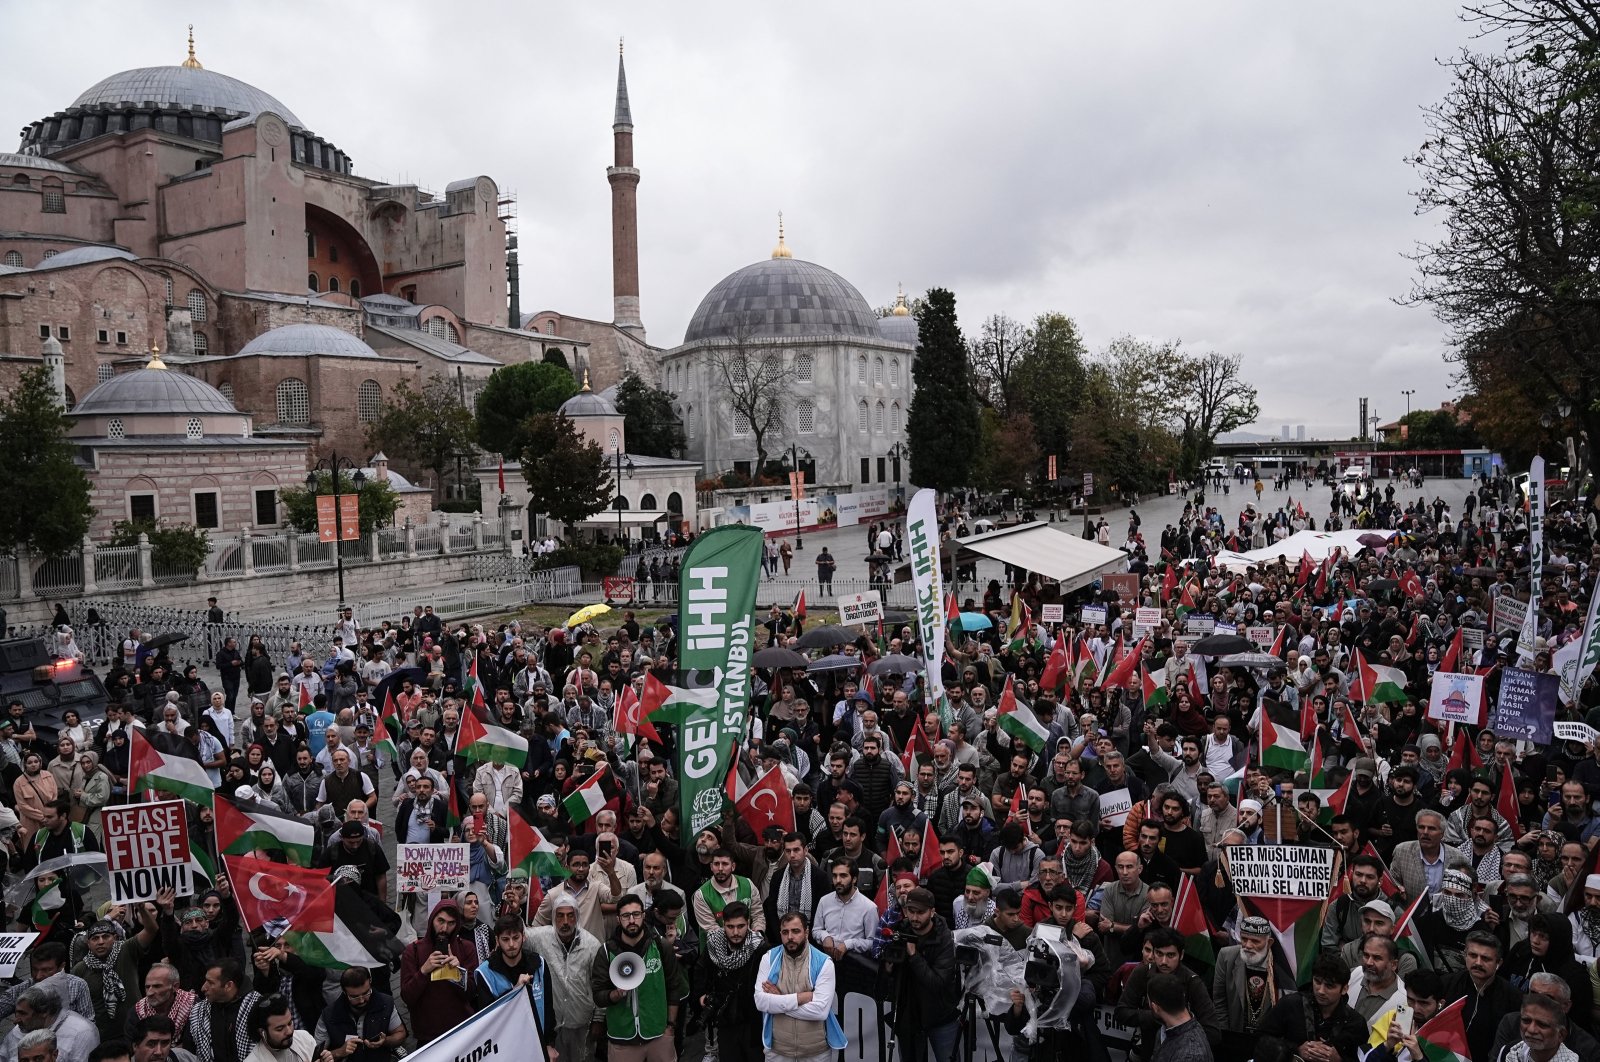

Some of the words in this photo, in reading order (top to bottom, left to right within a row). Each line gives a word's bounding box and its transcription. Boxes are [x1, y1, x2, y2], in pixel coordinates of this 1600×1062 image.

[1504, 678, 1533, 687] LIKTAN
[1503, 686, 1536, 696] ÇIKMAK
[1502, 693, 1530, 703] BAŞKA
[1500, 701, 1524, 710] NASIL
[1499, 709, 1521, 717] OLUR
[107, 806, 180, 836] CEASE
[110, 830, 184, 870] FIRE
[405, 847, 434, 860] DOWN
[437, 848, 464, 860] WITH
[1230, 847, 1255, 862] HER
[1258, 847, 1327, 864] MÜSLÜMAN
[1247, 864, 1270, 878] KOVA
[1272, 864, 1284, 878] SU
[1287, 864, 1330, 880] DÖKERSE
[114, 865, 187, 901] NOW!
[1273, 880, 1293, 895] SEL
[1298, 881, 1329, 898] ALIR!
[0, 952, 22, 964] UZ!
